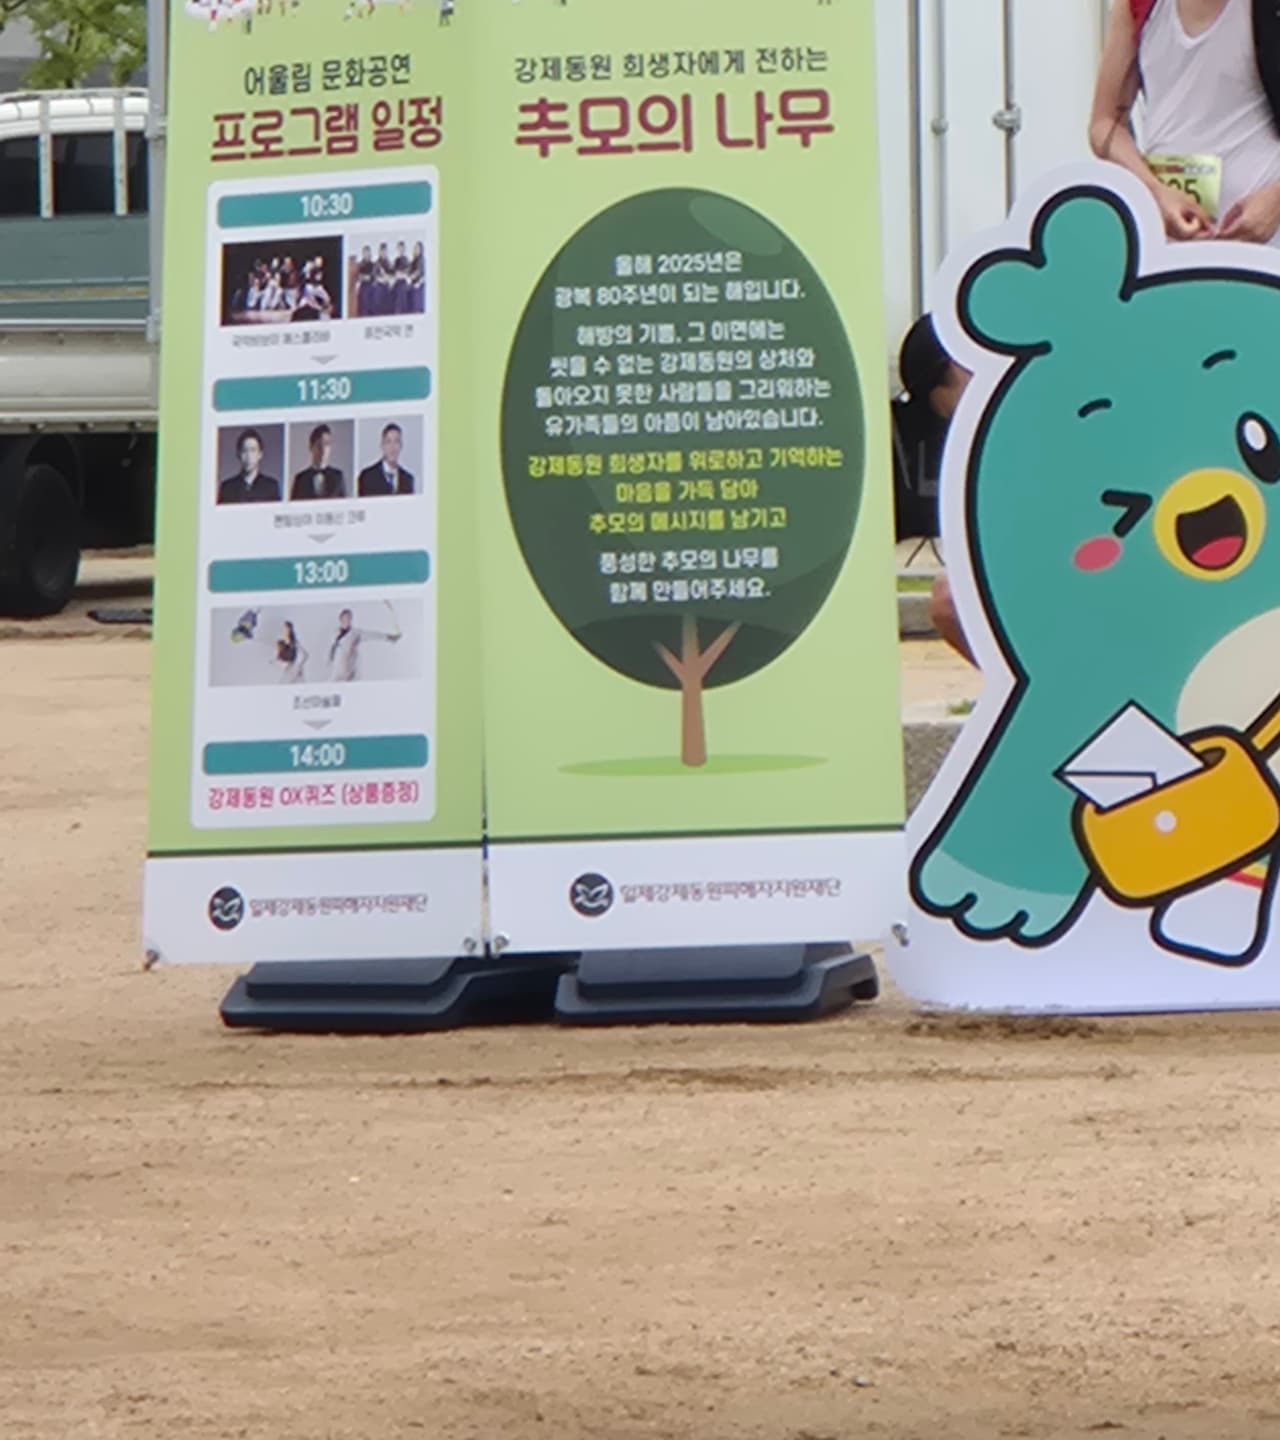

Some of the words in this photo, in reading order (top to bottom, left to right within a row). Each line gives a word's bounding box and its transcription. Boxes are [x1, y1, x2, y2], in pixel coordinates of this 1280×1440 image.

[245, 63, 311, 95] 어울림
[323, 54, 410, 91] 문화공연
[515, 55, 612, 83] 강제동원
[623, 50, 745, 78] 희생자에게
[756, 48, 828, 74] 전하는
[211, 103, 358, 162] 프로그램
[372, 96, 442, 151] 일정
[515, 93, 693, 158] 추모의
[715, 89, 834, 149] 나무
[300, 193, 353, 217] 10:30
[616, 254, 652, 277] 올해
[657, 251, 742, 274] 2025년은
[555, 286, 592, 308] 광복
[596, 283, 677, 306] 80주년이
[682, 282, 720, 303] 되는
[725, 278, 806, 301] 해입니다.
[577, 324, 633, 347] 해방의
[687, 322, 706, 343] 그
[711, 319, 786, 342] 이면에는
[550, 356, 587, 378] 씻을
[593, 356, 612, 376] 수
[617, 354, 654, 376] 없는
[660, 350, 753, 374] 강제동원의
[758, 348, 816, 371] 상처와
[297, 377, 351, 401] 11:30
[535, 385, 610, 409] 돌아오지
[615, 383, 653, 405] 못한
[658, 380, 733, 403] 사람들을
[739, 377, 832, 401] 그리워하는
[545, 412, 639, 437] 유가족들의
[644, 411, 700, 434] 아픔이
[705, 407, 824, 432] 남아있습니다.
[528, 454, 602, 478] 강제동원
[609, 451, 683, 474] 희생자를
[690, 448, 763, 471] 위로하고
[770, 446, 843, 468] 기억하는
[615, 482, 672, 503] 마음을
[678, 480, 715, 501] 가득
[720, 478, 759, 500] 담아
[589, 512, 645, 534] 추모의
[650, 509, 725, 532] 메시지를
[731, 507, 786, 529] 남기고
[294, 559, 348, 584] 13:00
[599, 551, 656, 575] 풍성한
[661, 550, 717, 572] 추모의
[722, 546, 779, 570] 나무를
[609, 581, 647, 603] 함께
[652, 577, 771, 602] 만들어주세요.
[290, 743, 345, 767] 14:00
[208, 785, 274, 810] 강제동원
[280, 783, 336, 806] OX퀴즈
[342, 780, 419, 805] (상품증정)
